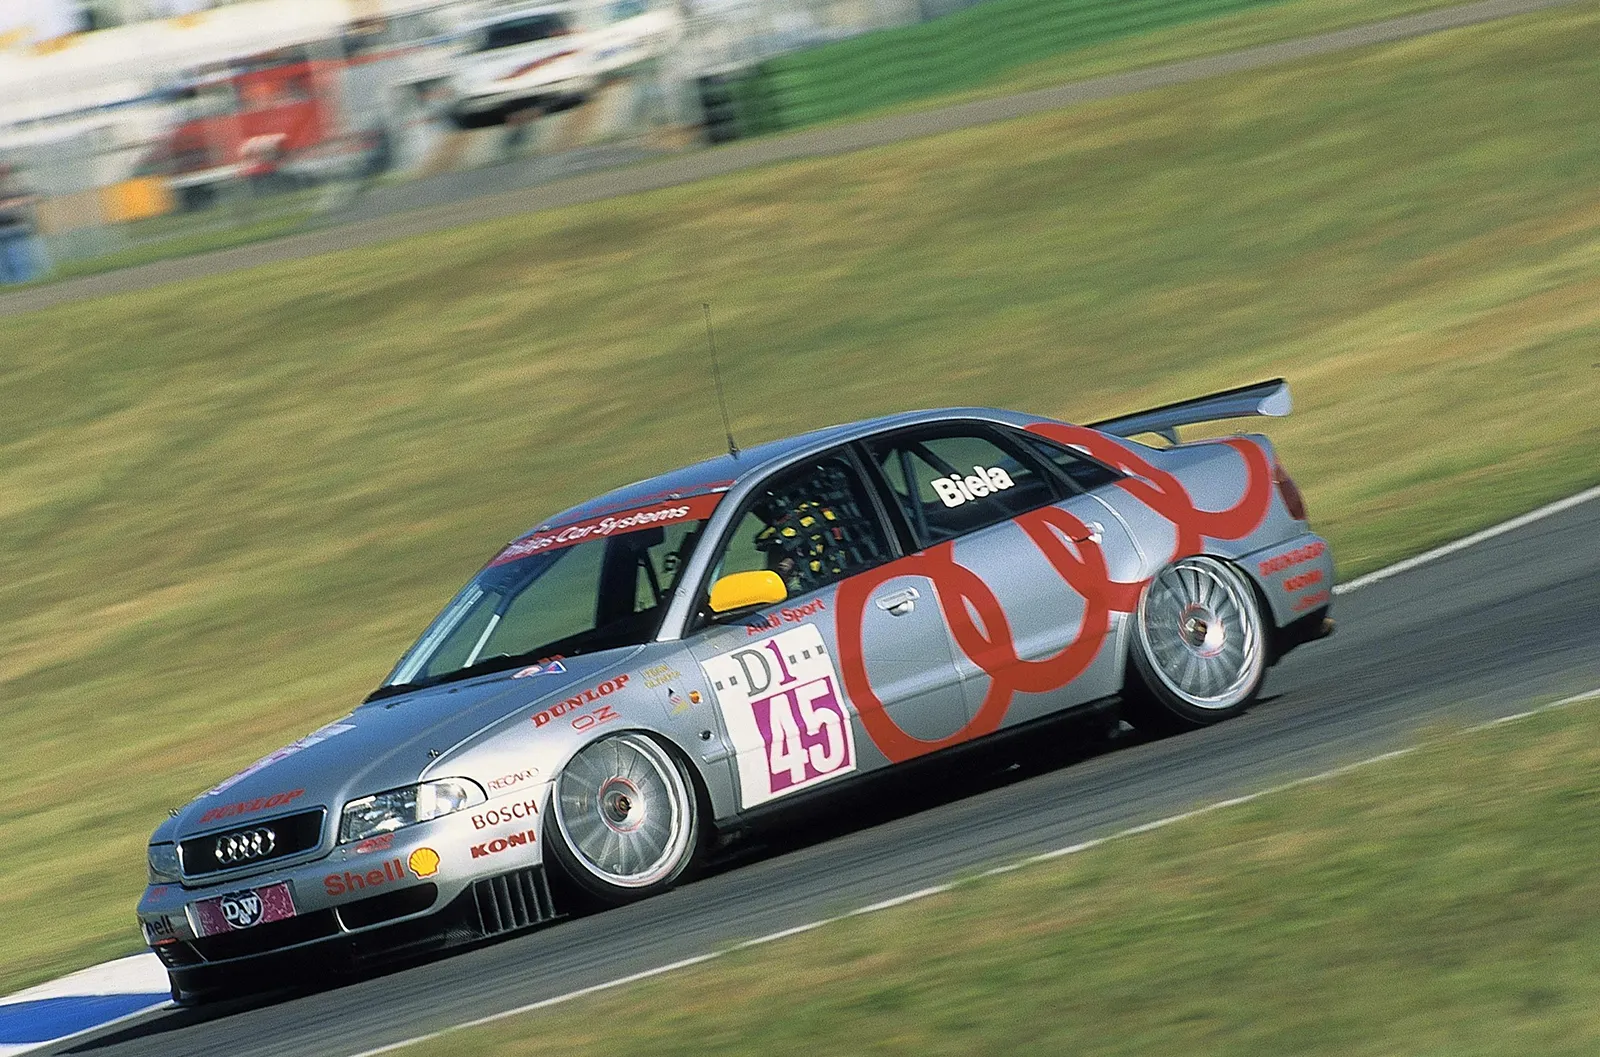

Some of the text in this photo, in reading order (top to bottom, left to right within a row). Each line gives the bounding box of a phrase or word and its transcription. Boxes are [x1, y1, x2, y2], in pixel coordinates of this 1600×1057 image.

[930, 465, 1015, 508] Biela
[555, 525, 593, 543] Car
[594, 505, 691, 535] Systems
[745, 598, 826, 636] Audi Sport
[730, 639, 797, 697] D1
[531, 673, 631, 729] DUNLOP
[767, 676, 847, 786] 45
[198, 788, 306, 825] DUNLOP
[471, 799, 539, 831] BOSCH
[470, 829, 537, 859] KONI
[323, 858, 405, 896] Shell
[144, 914, 175, 936] hell
